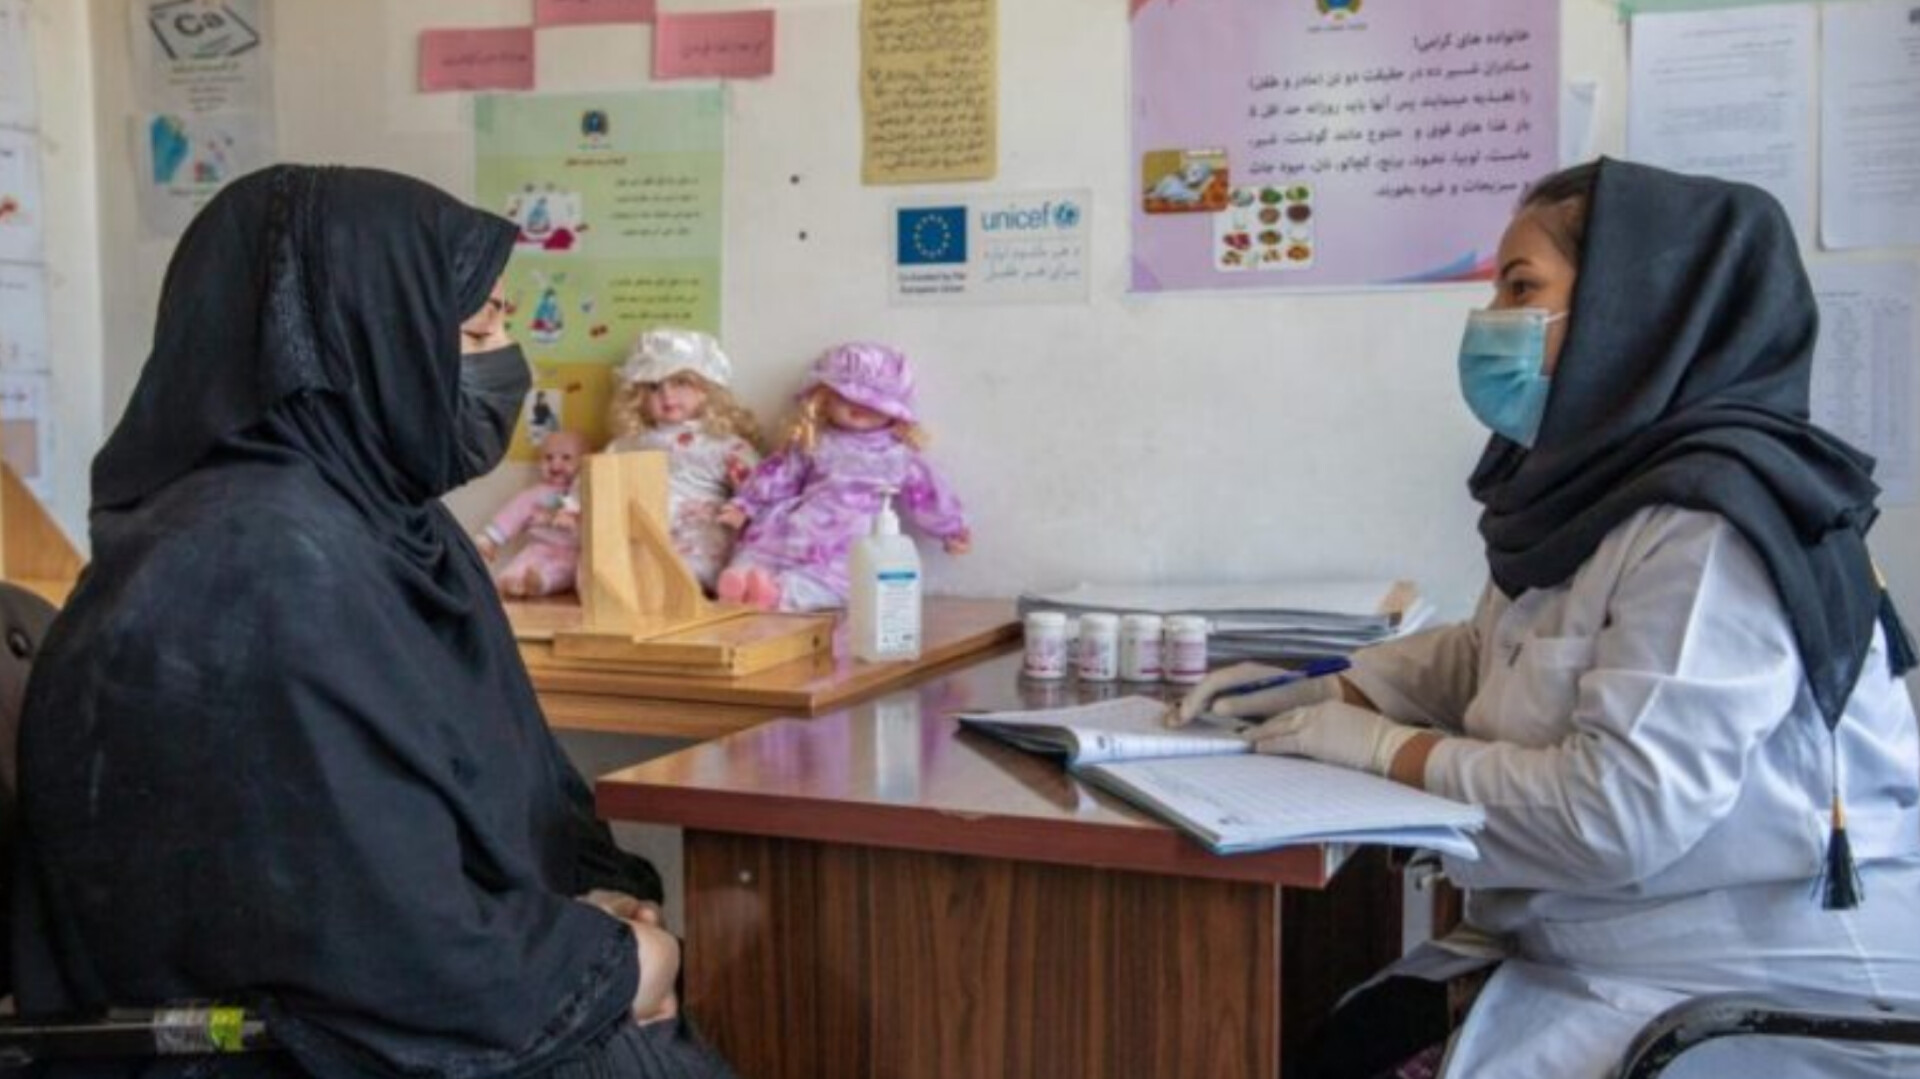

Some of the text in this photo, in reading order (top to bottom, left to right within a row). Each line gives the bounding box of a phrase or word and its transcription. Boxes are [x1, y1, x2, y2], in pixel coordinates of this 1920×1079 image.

[174, 10, 226, 37] Ca
[1456, 33, 1481, 49] های
[980, 202, 1051, 231] unicef
